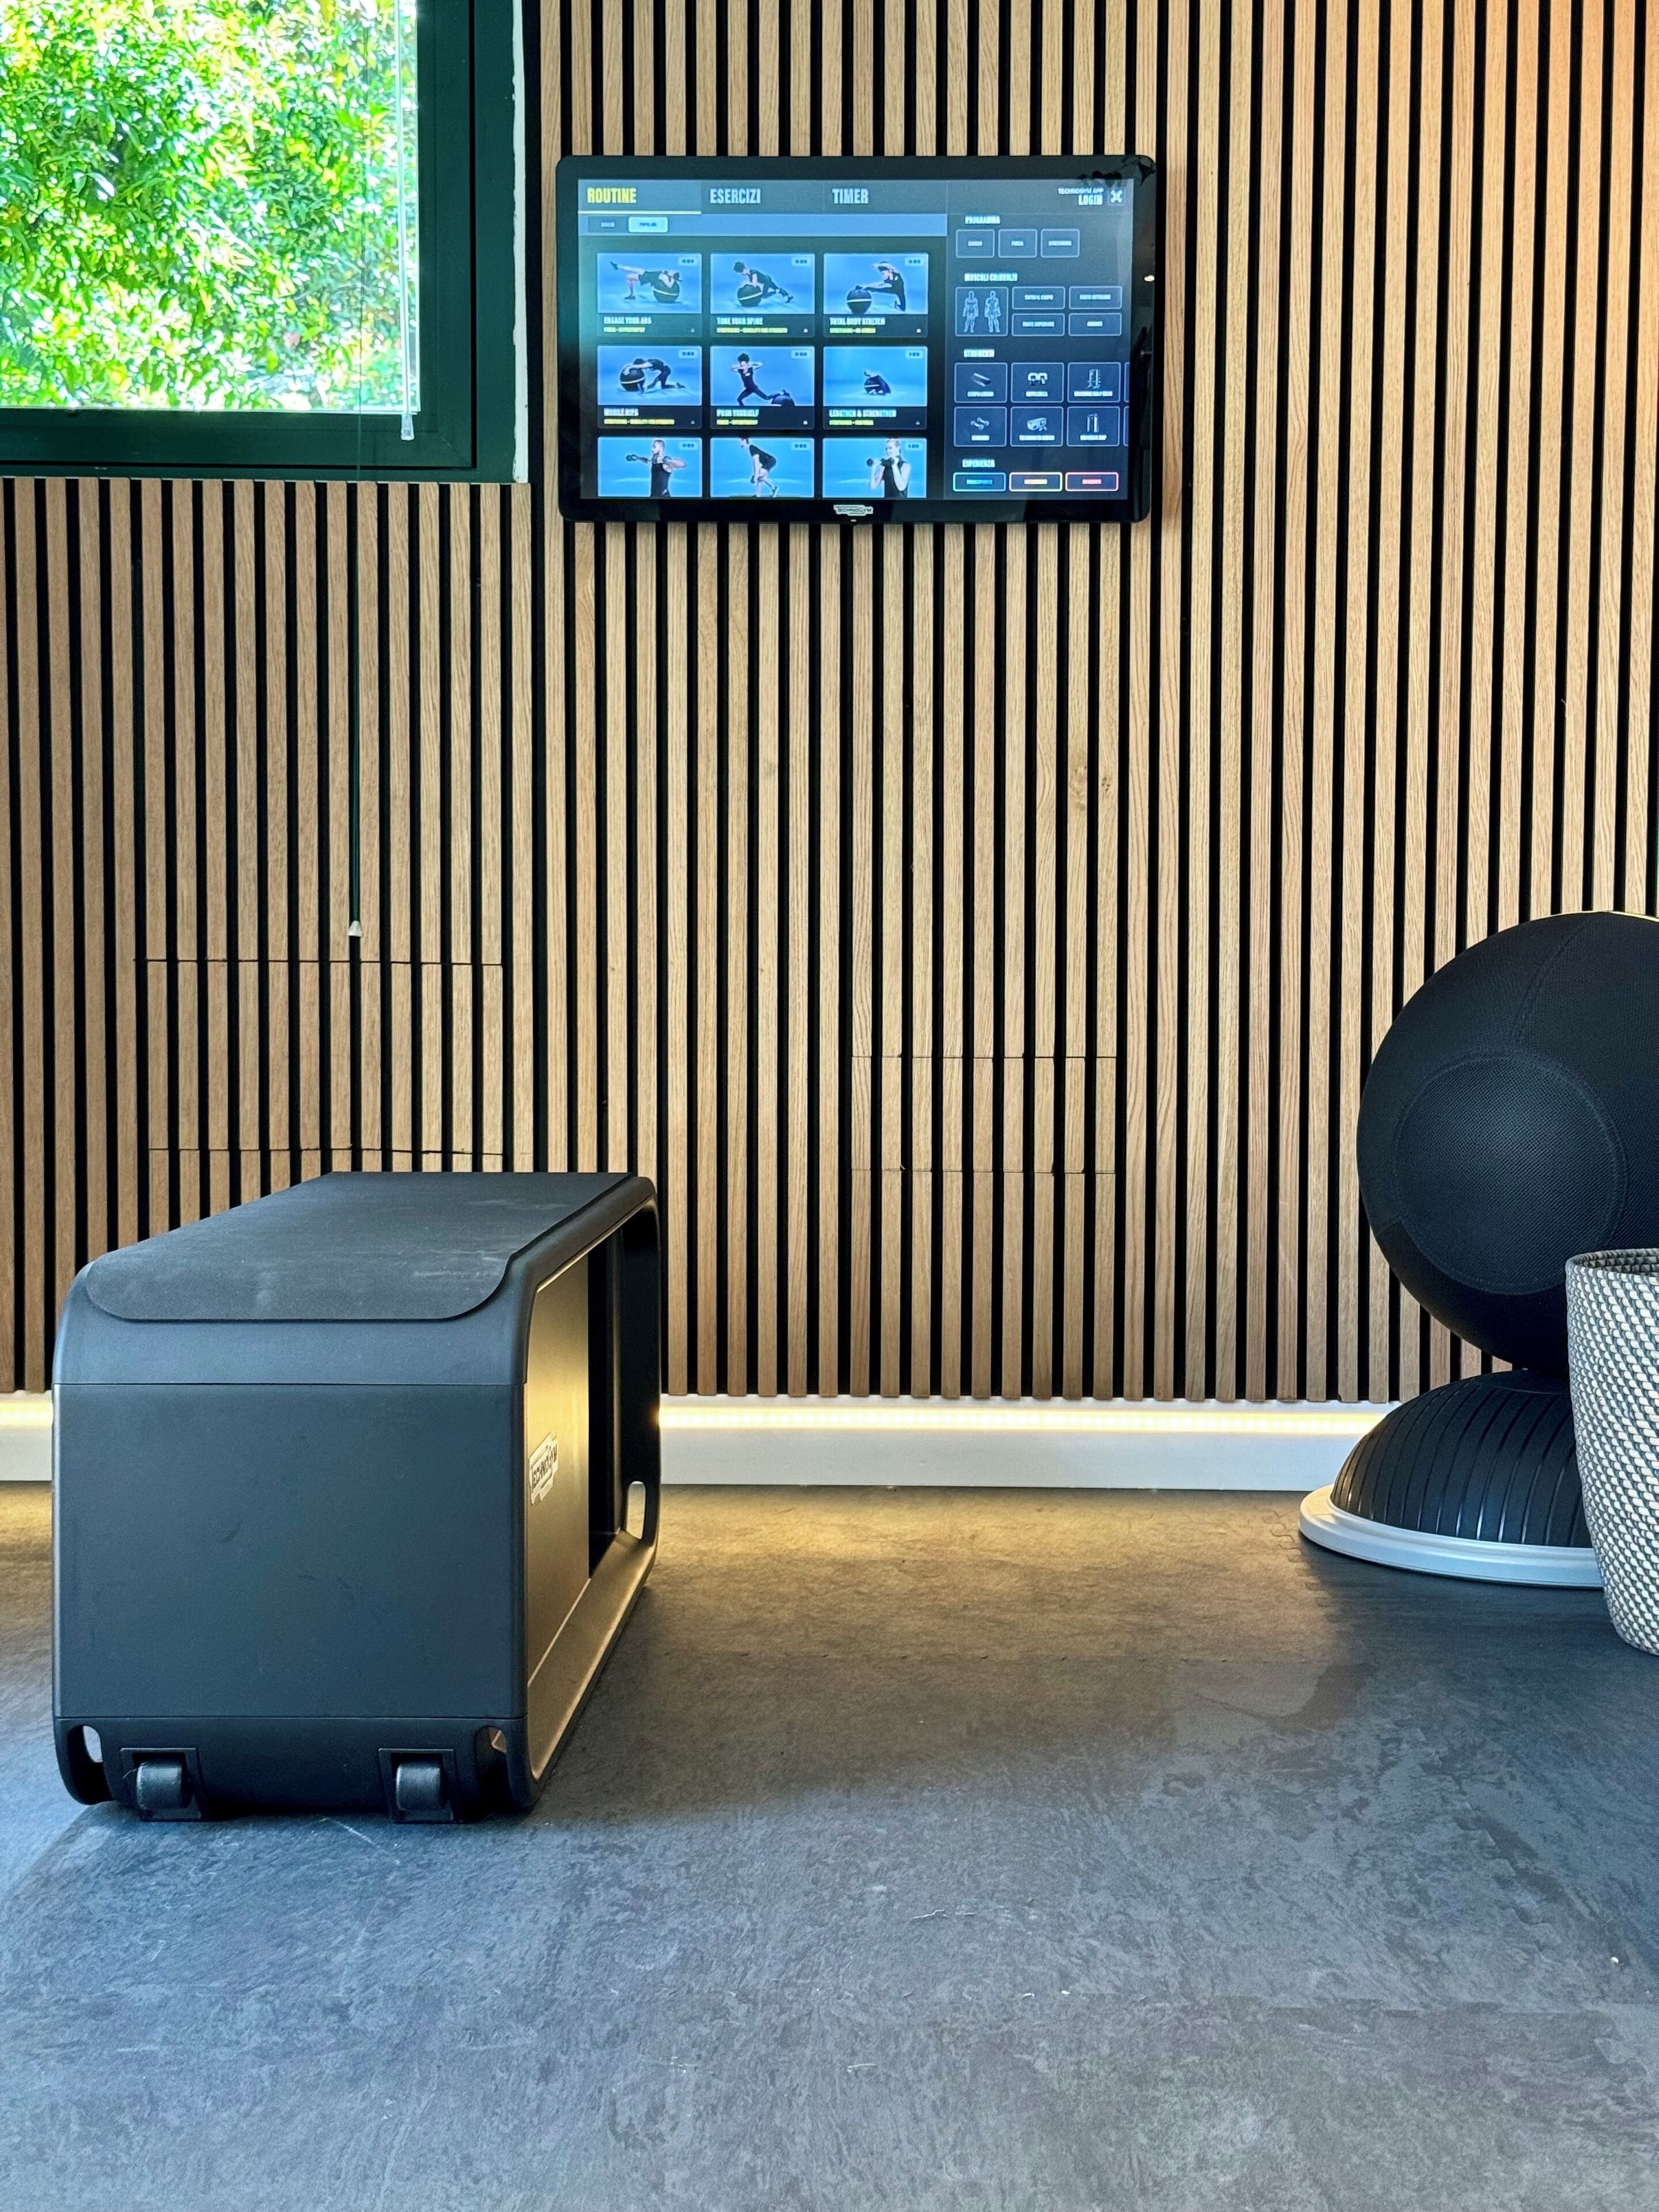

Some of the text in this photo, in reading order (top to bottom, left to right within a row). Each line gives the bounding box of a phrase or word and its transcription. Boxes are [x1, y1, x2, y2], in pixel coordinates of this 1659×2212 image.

[586, 187, 637, 203] ROUTINE
[709, 188, 761, 204] ESERCIZI
[831, 188, 869, 204] TIMER
[1078, 194, 1103, 205] LOGIN
